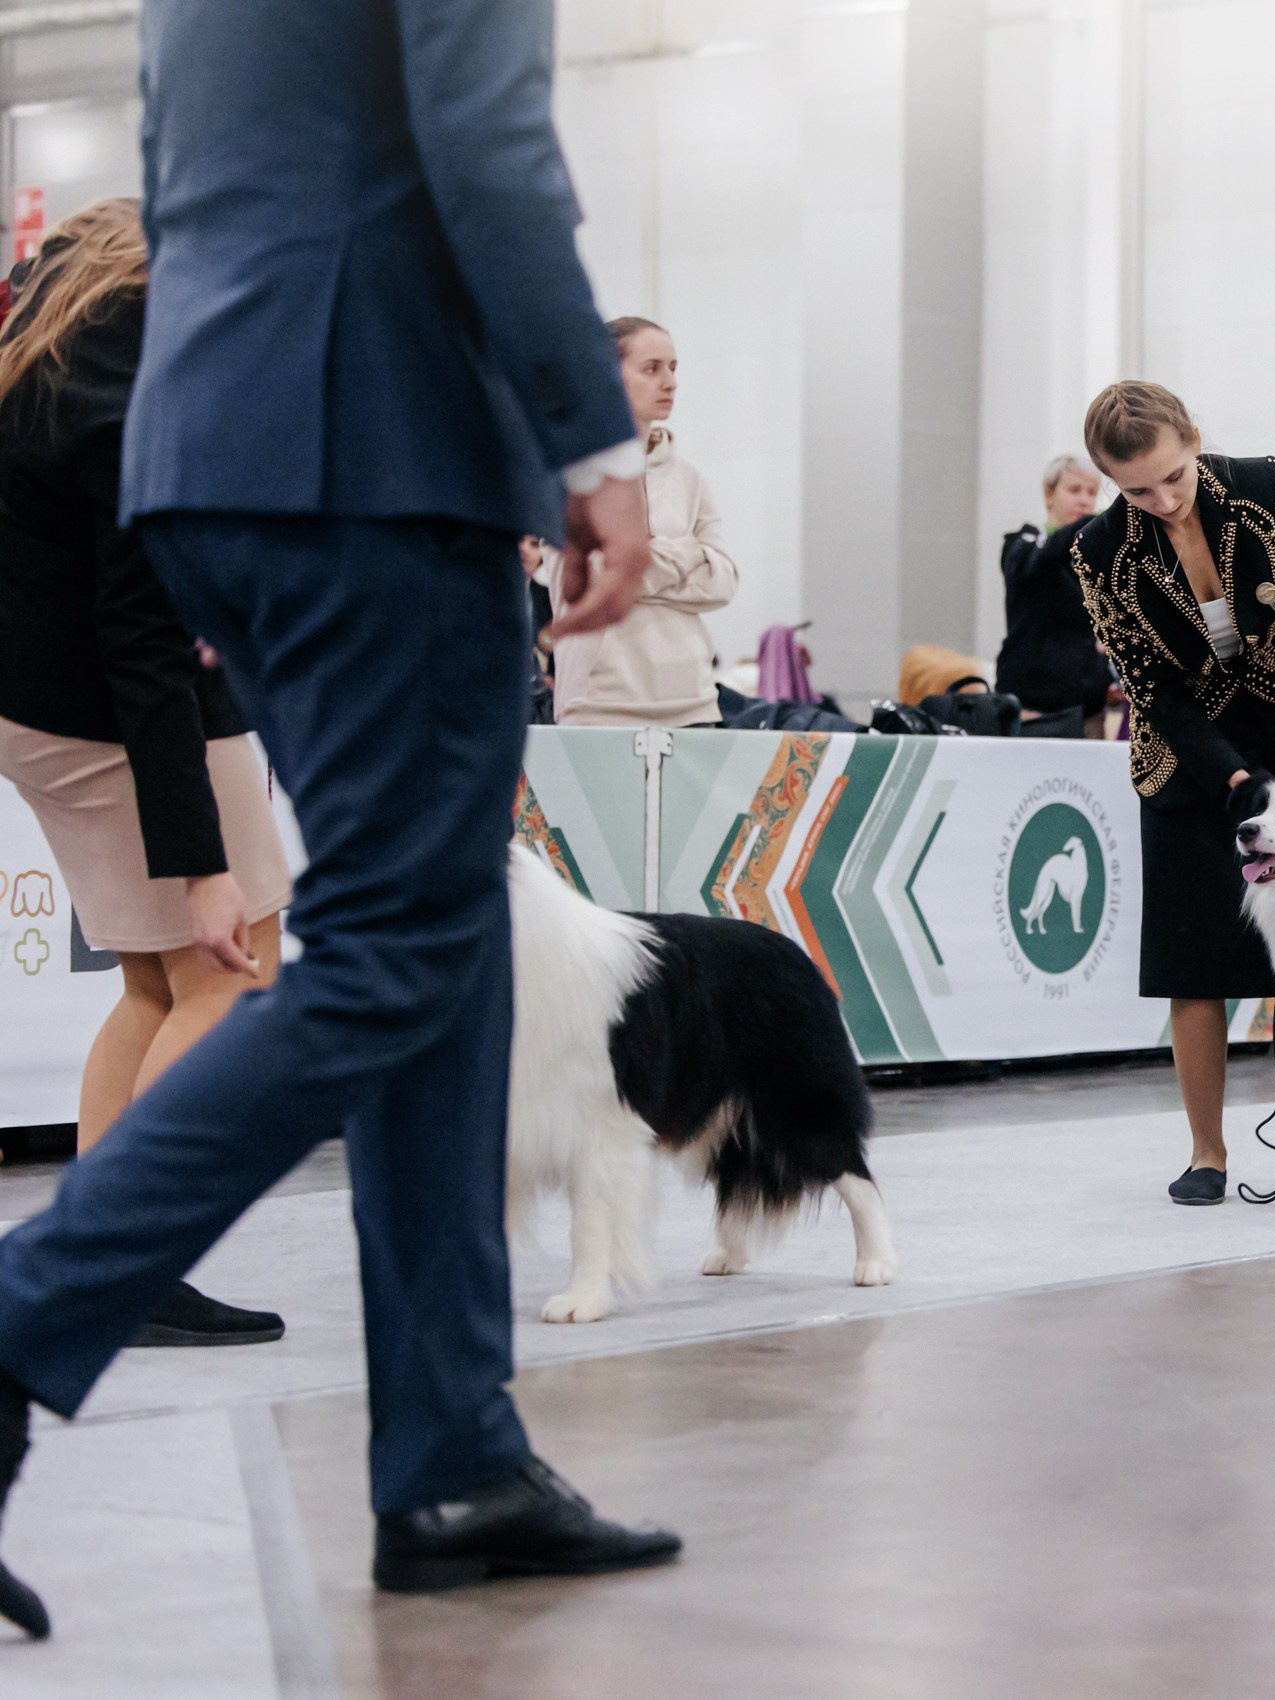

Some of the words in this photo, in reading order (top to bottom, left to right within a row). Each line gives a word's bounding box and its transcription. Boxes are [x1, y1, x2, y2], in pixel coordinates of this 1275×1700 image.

[1008, 777, 1118, 853] КИНОЛОГИЧЕСКАЯ
[993, 835, 1031, 984] РОССИЙСКАЯ
[1081, 858, 1121, 983] ФЕДЕРАЦИЯ
[1043, 983, 1070, 1000] 1991
